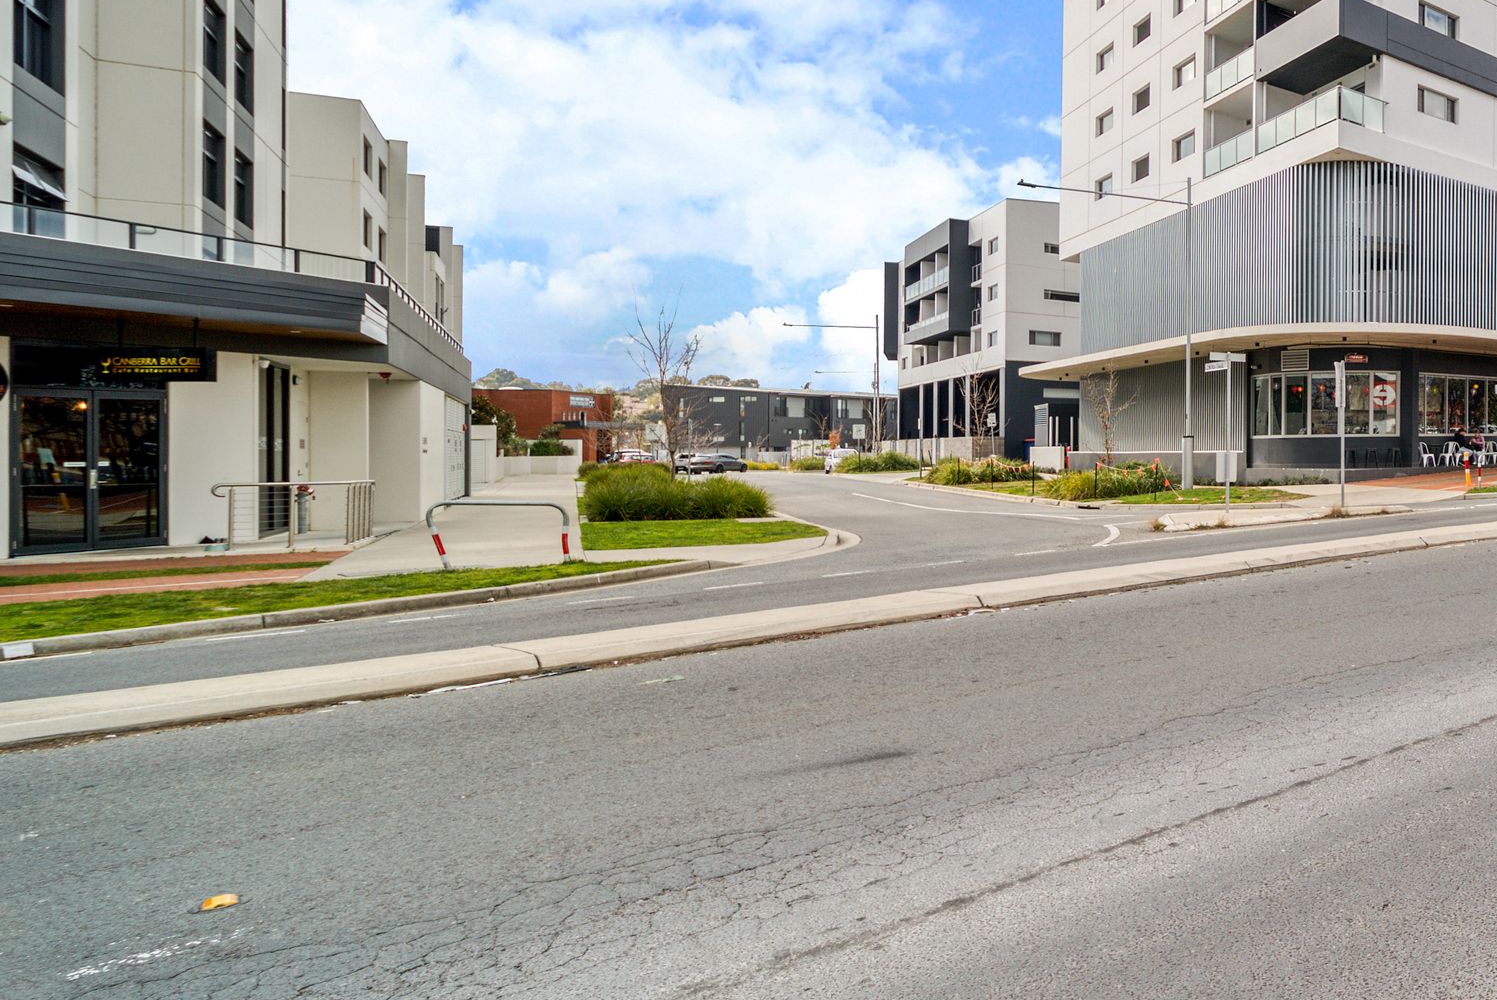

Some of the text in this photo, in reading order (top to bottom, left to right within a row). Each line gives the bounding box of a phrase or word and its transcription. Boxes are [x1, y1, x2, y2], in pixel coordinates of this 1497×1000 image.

[112, 357, 201, 366] CANBERRA BAR GRILL
